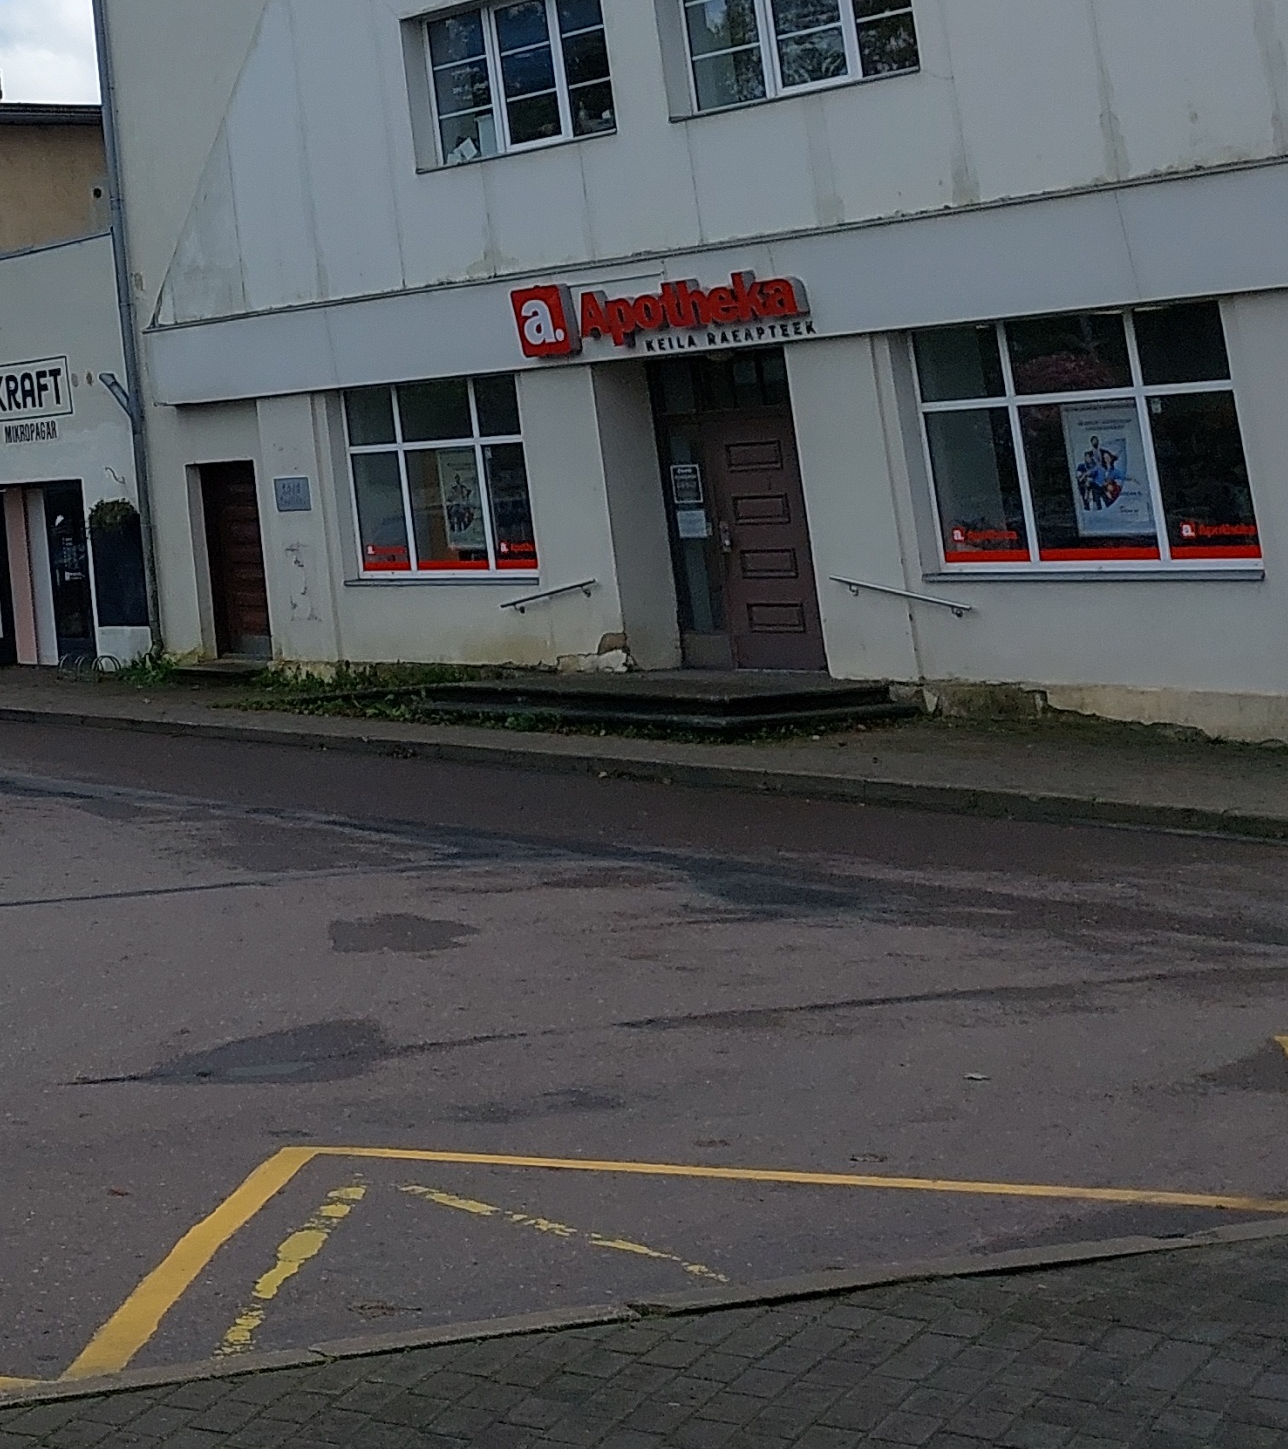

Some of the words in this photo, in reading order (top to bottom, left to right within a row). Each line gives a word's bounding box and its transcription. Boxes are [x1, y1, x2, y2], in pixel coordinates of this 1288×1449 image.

[580, 270, 798, 348] Apotheka
[645, 336, 697, 353] KEILA
[708, 320, 818, 347] RAEAPTEEK
[4, 420, 58, 444] MIKROPAGAR
